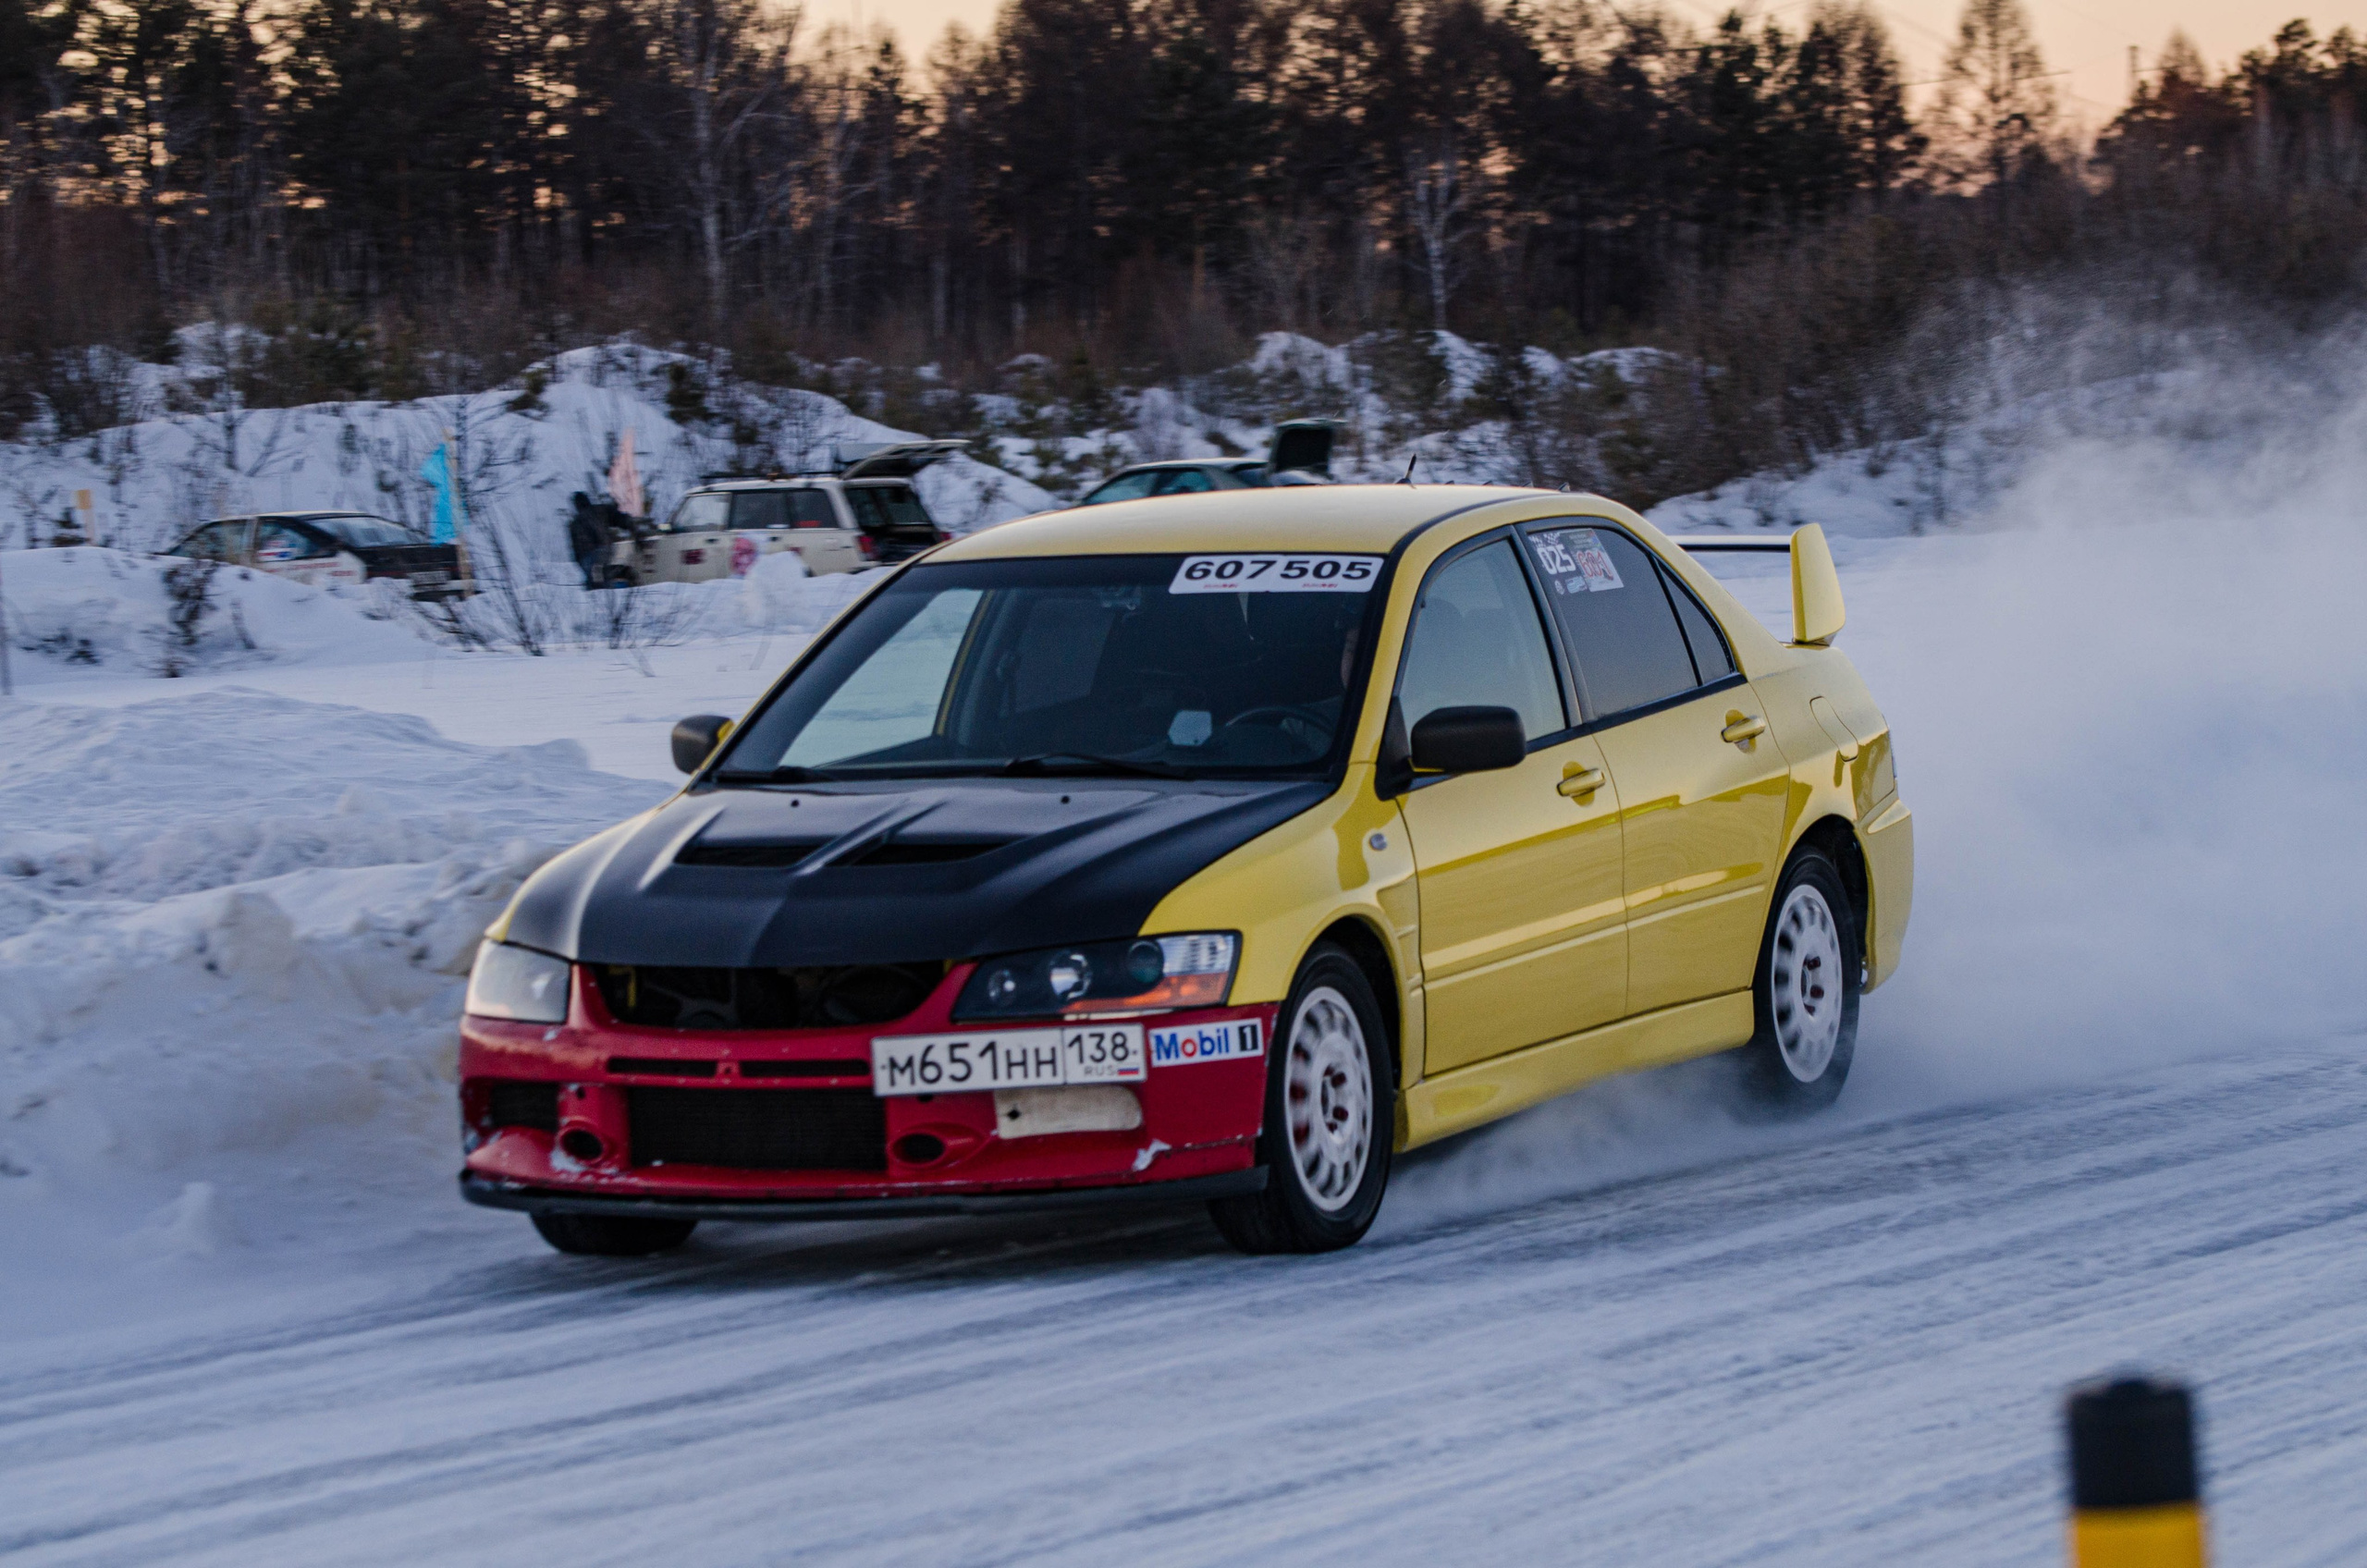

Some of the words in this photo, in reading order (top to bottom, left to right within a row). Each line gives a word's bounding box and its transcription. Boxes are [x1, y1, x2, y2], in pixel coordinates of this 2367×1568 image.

[1537, 544, 1576, 574] 025
[1067, 1032, 1130, 1063] 138
[1155, 1027, 1230, 1060] Mobil
[1241, 1025, 1255, 1051] 1
[1084, 1064, 1118, 1076] RUS
